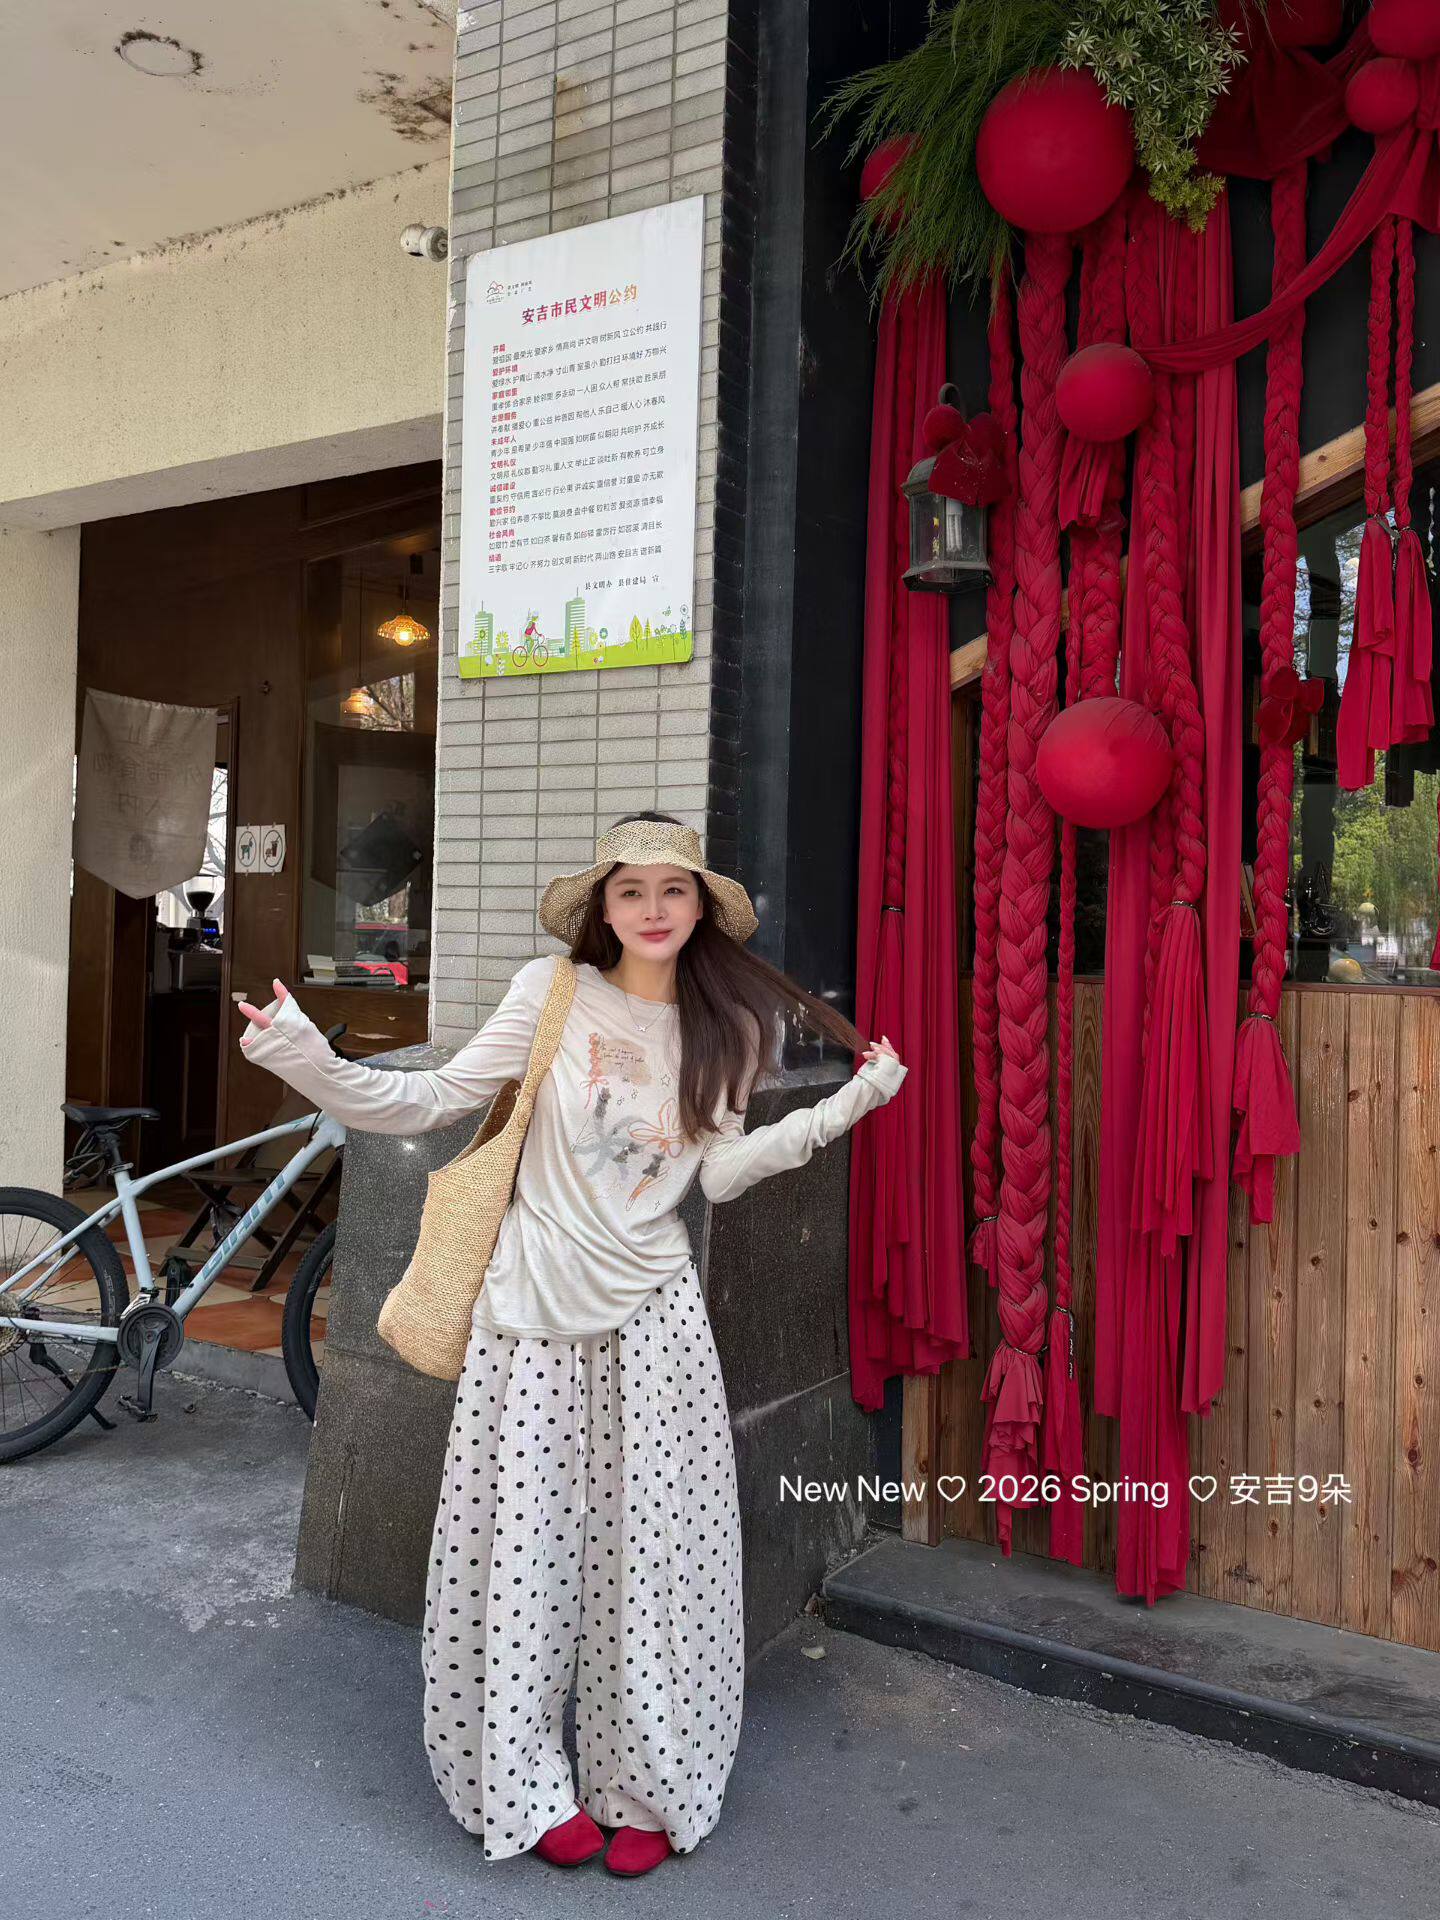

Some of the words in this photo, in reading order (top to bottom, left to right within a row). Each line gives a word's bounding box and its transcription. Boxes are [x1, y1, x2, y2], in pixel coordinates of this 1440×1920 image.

[522, 284, 638, 326] 安吉市民文明公约
[577, 334, 598, 347] 讲文明
[599, 329, 620, 342] 树新风
[622, 324, 643, 337] 立公约
[622, 349, 643, 362] 环境好
[645, 344, 666, 357] 万物兴
[555, 387, 575, 399] 多走动
[576, 383, 597, 395] 一人困
[598, 378, 619, 391] 众人帮
[598, 403, 619, 415] 乐自己
[491, 435, 516, 446] 未成年人
[490, 447, 510, 458] 青少年
[490, 458, 516, 469] 文明礼仪
[530, 558, 550, 569] 齐努力
[551, 555, 571, 566] 创文明
[573, 552, 593, 563] 新时代
